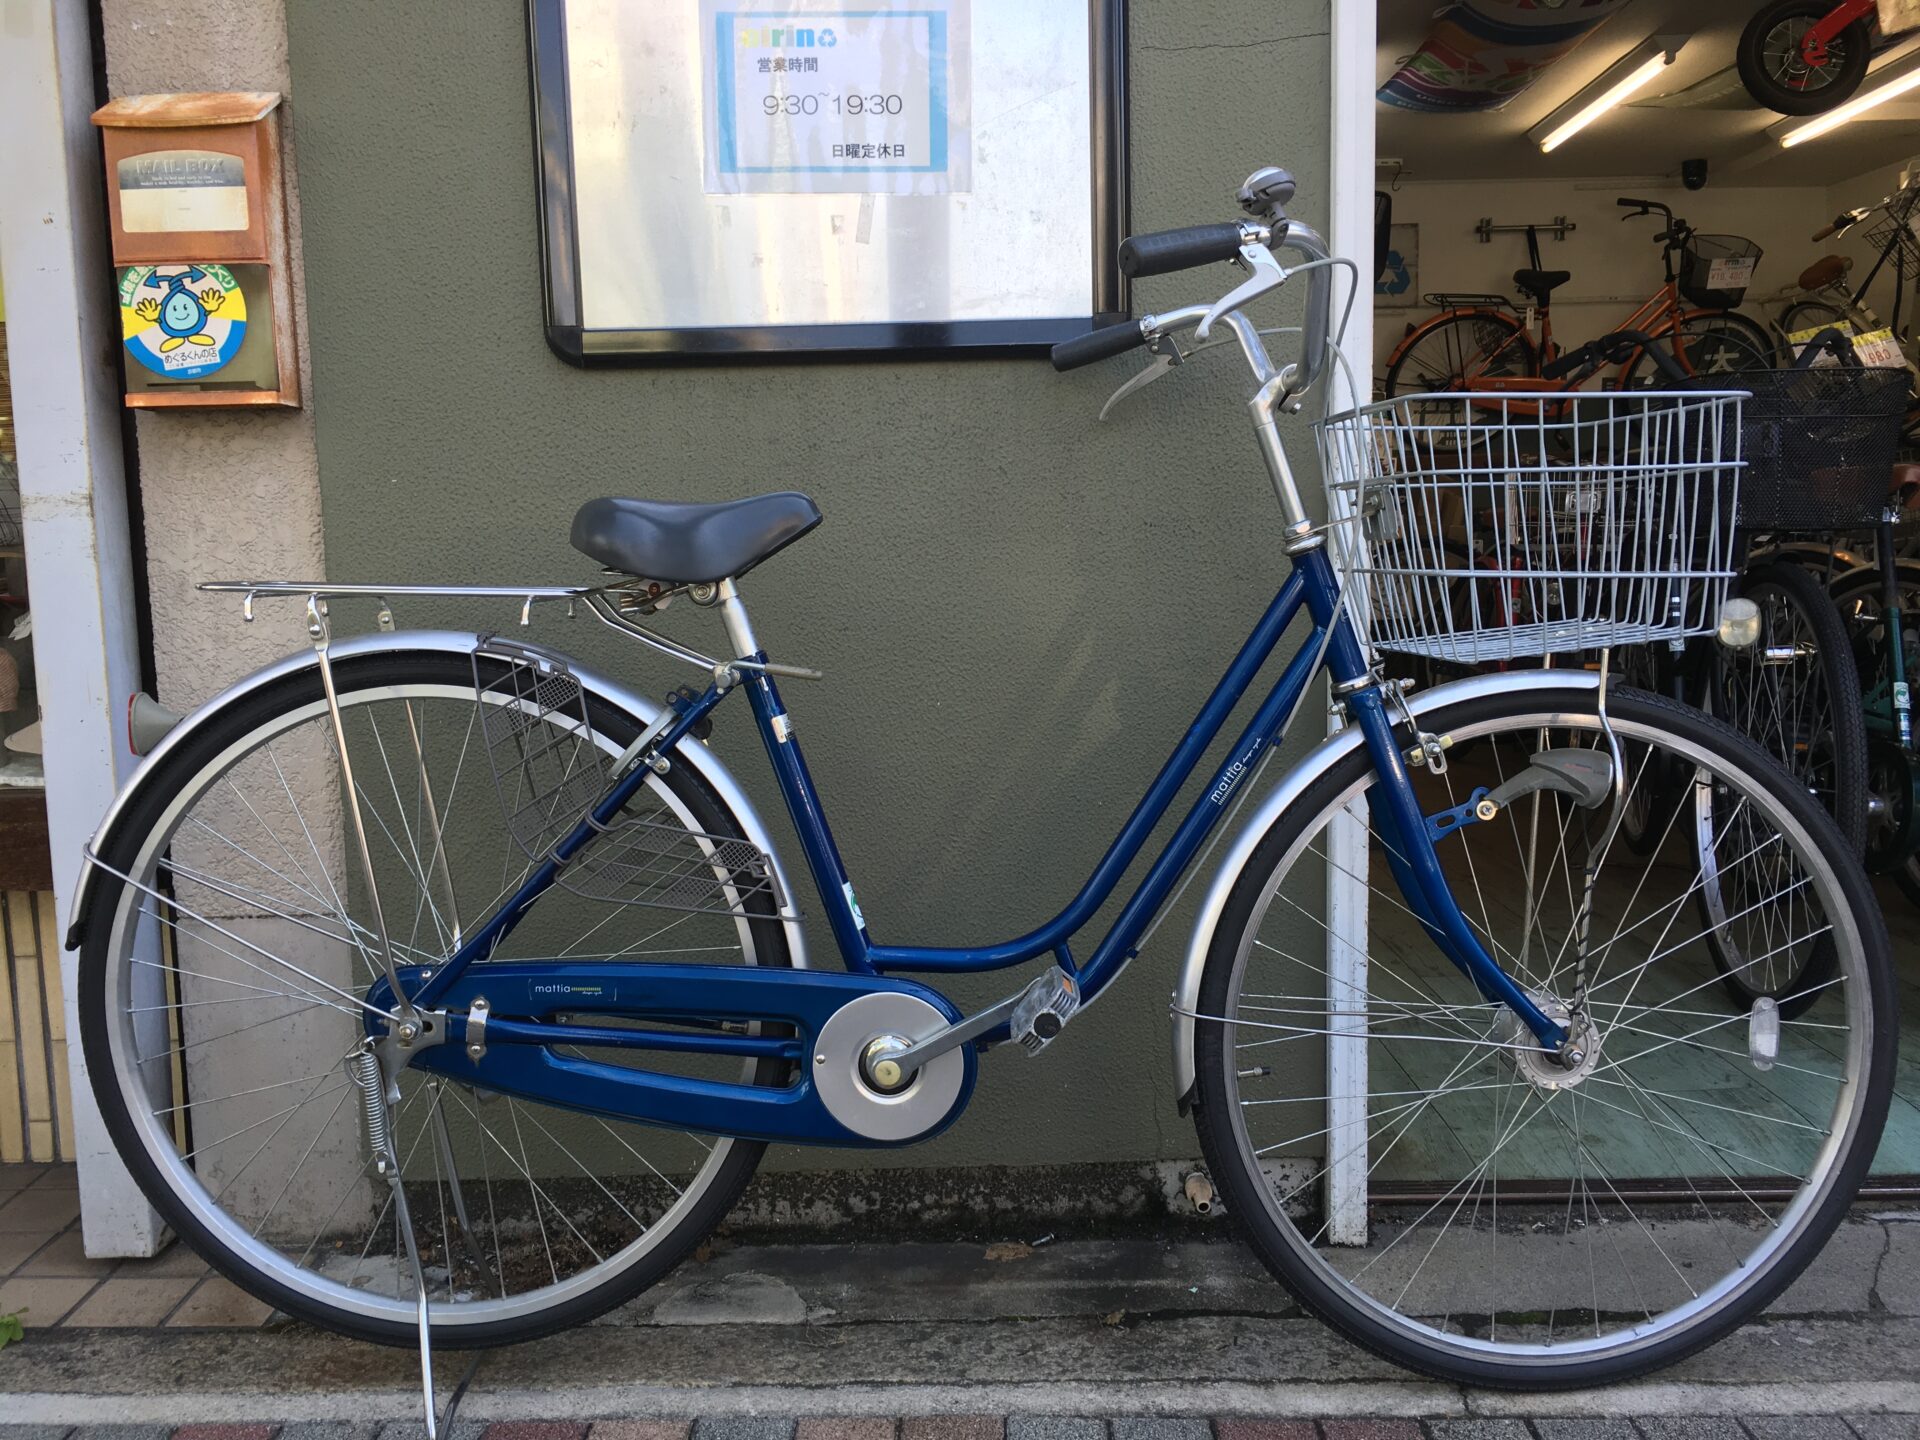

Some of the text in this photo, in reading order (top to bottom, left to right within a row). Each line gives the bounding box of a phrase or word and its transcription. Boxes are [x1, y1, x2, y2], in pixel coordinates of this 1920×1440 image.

[757, 57, 819, 73] 営業時間
[832, 143, 905, 159] 日曜定休日
[136, 157, 225, 176] MAIL BOX
[164, 347, 218, 364] めぐるくんの店
[1210, 761, 1243, 803] mattia
[535, 983, 571, 993] mattia
